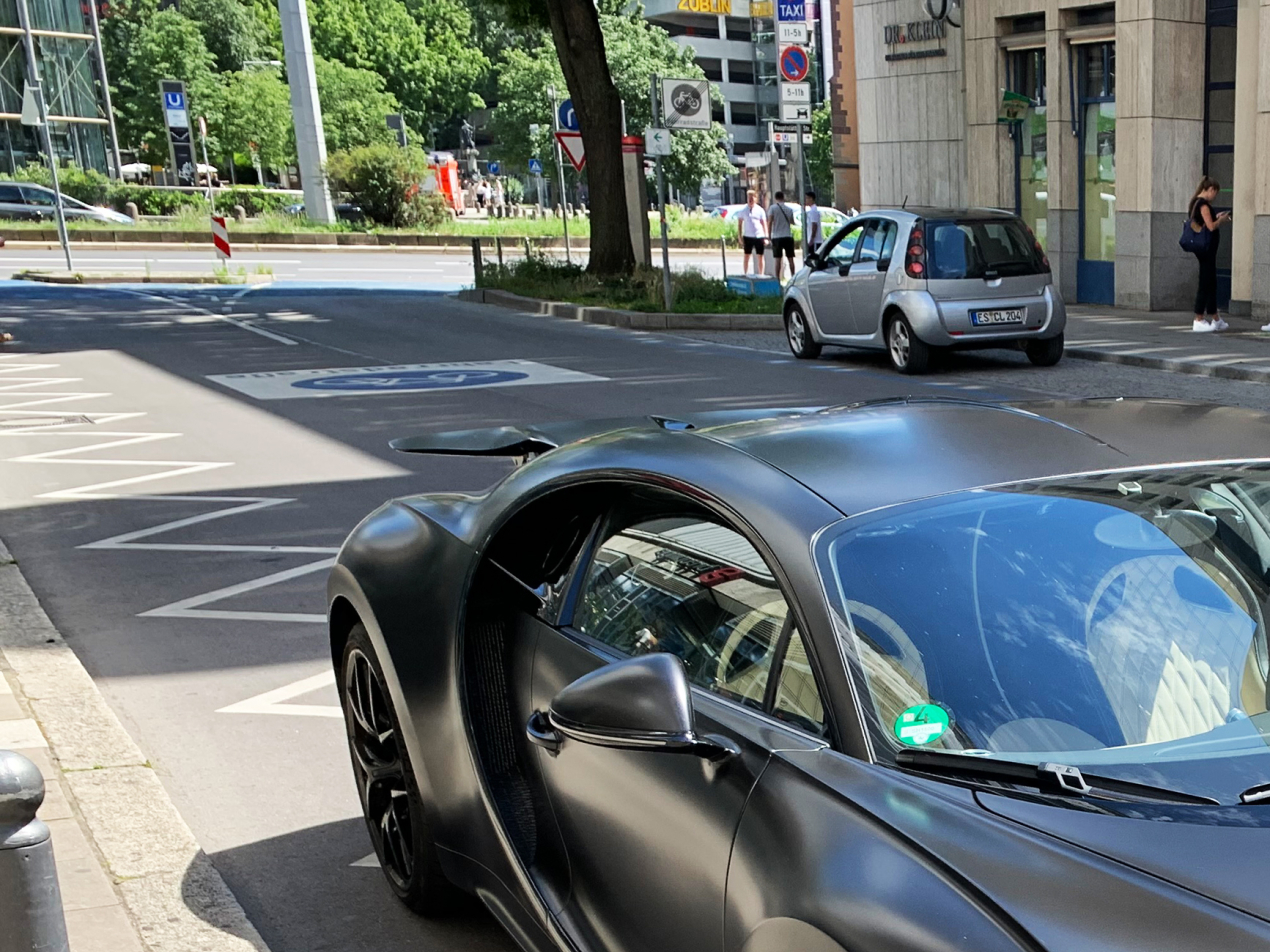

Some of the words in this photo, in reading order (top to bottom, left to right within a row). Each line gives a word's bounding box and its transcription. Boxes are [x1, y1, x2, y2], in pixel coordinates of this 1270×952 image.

[780, 5, 803, 17] TAXI
[784, 28, 801, 37] 11-5h
[907, 20, 945, 41] KLEIN
[168, 94, 180, 106] U
[977, 312, 990, 322] ES
[993, 311, 1006, 321] CL
[1006, 310, 1021, 320] 204
[913, 706, 928, 724] 4
